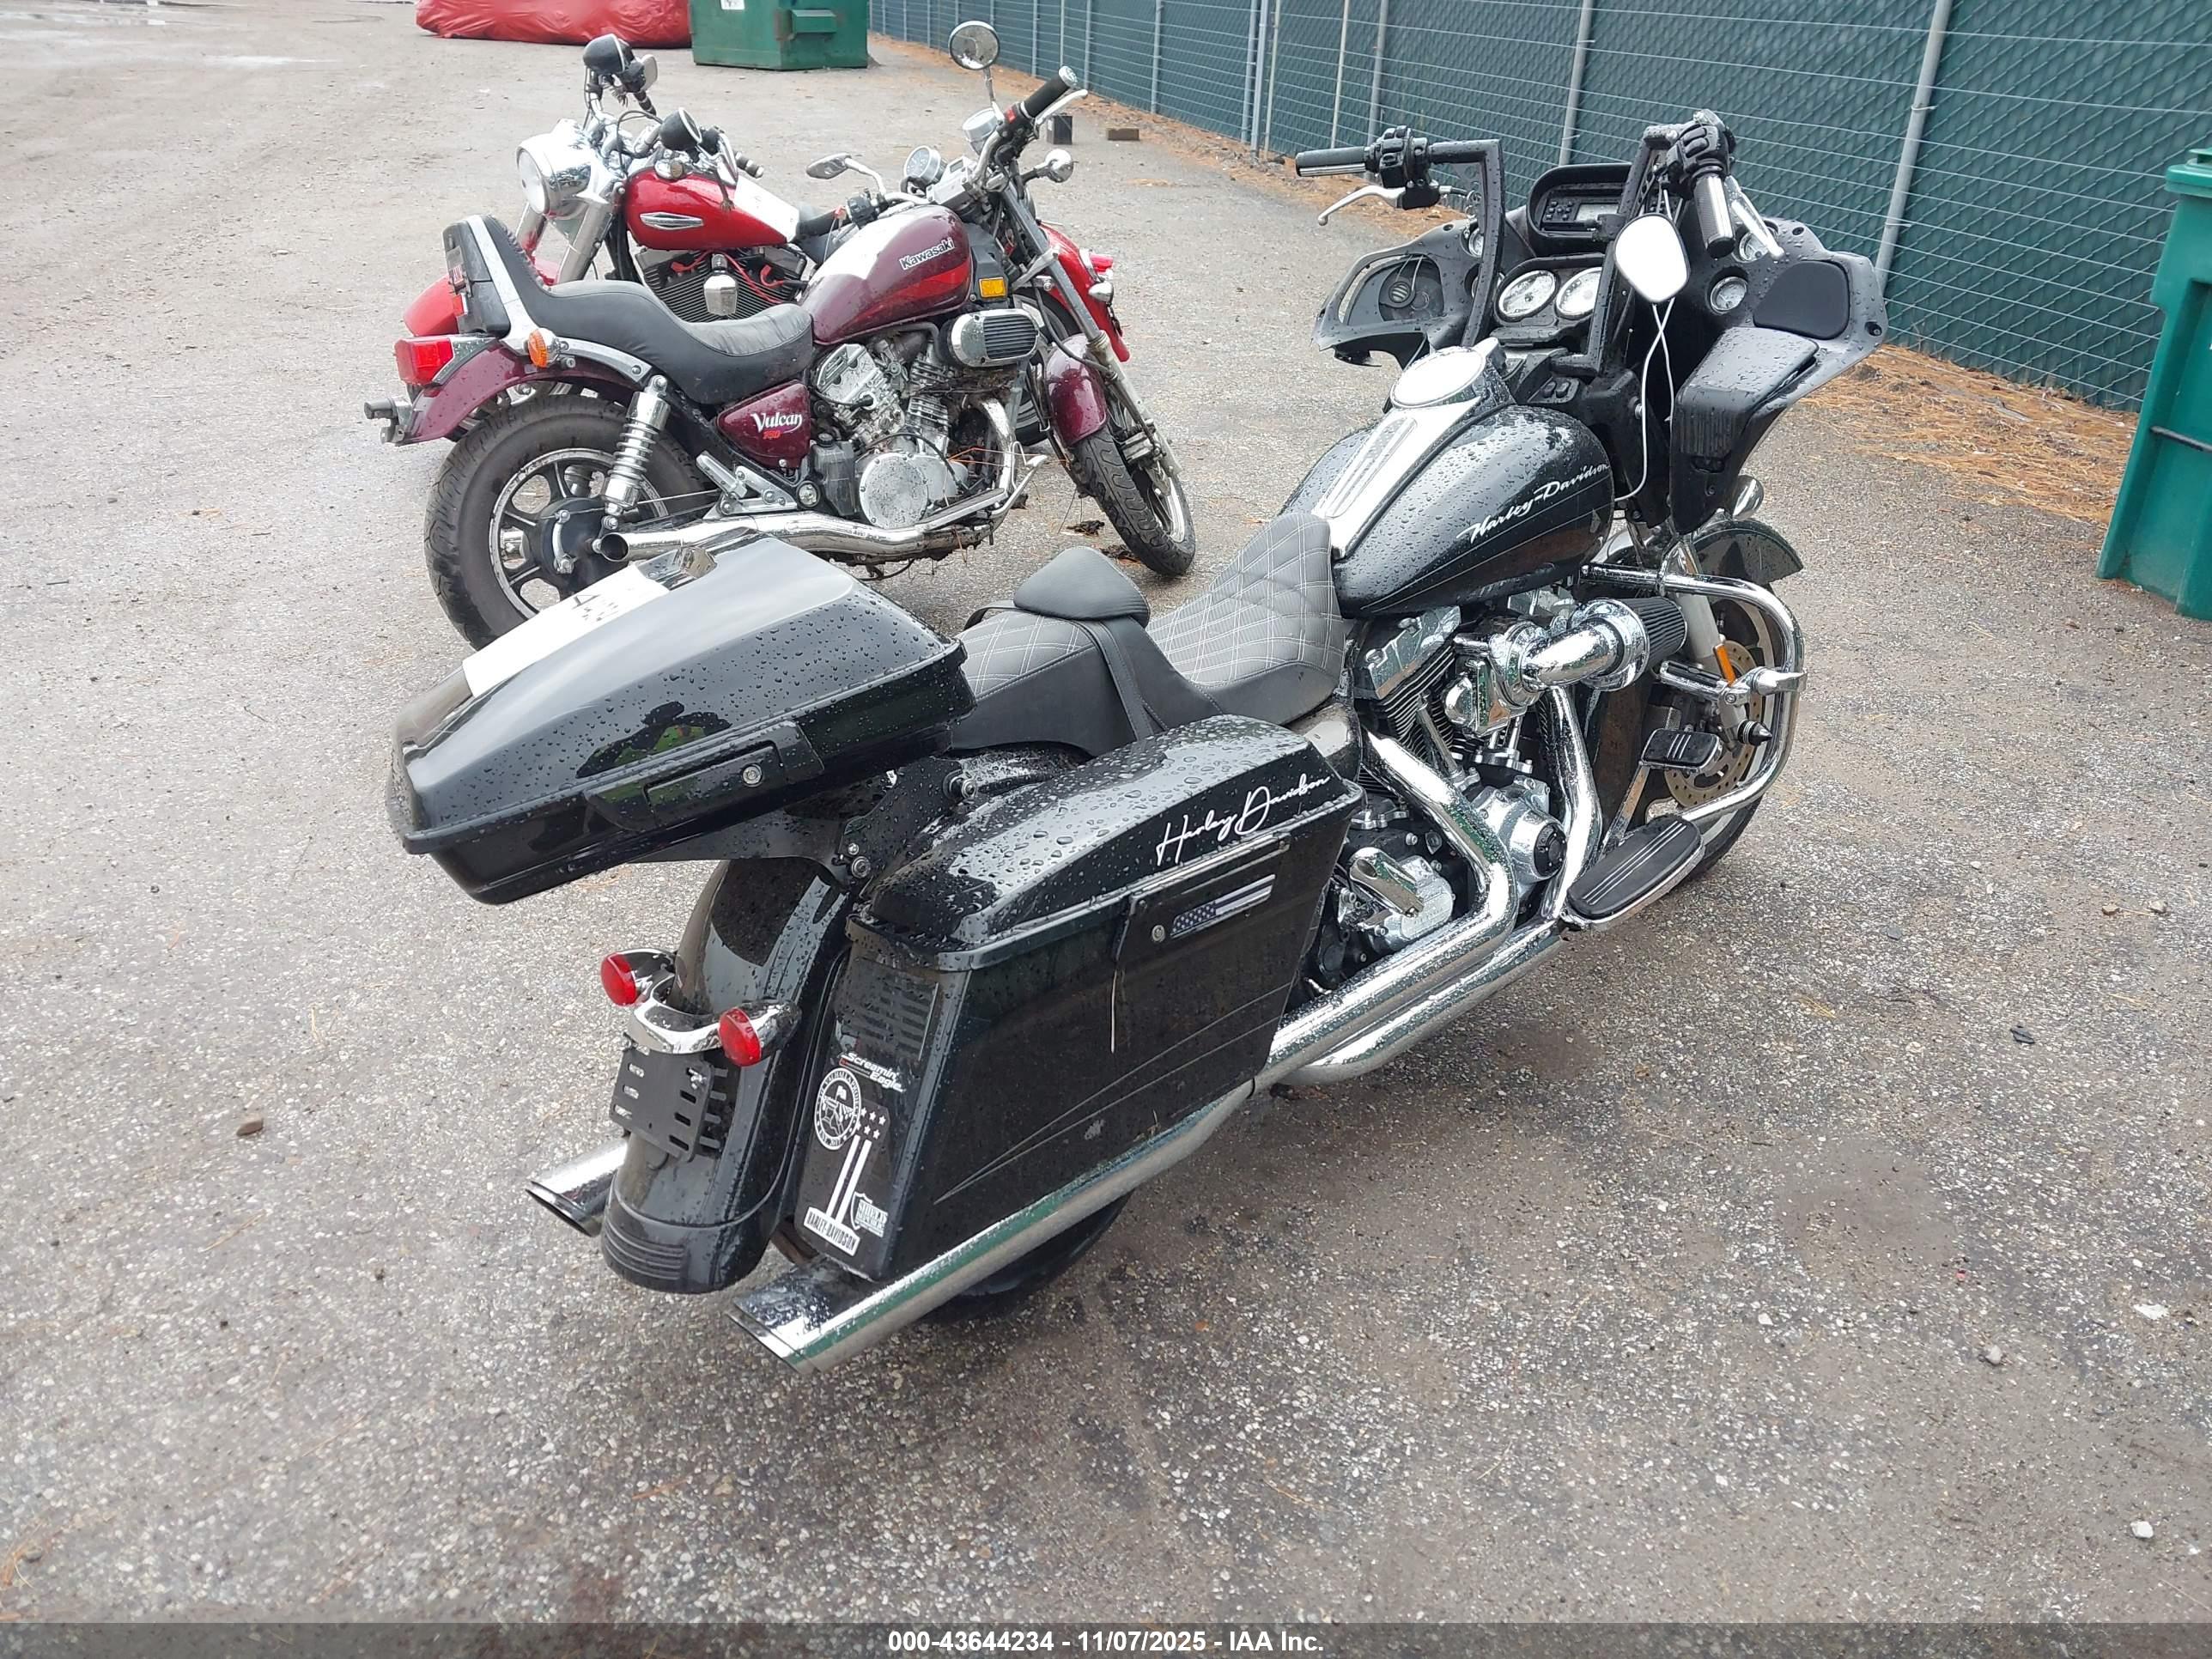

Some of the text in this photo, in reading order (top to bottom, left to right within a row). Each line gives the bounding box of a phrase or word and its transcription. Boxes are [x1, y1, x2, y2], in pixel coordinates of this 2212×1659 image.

[899, 237, 955, 270] Kawasaki
[750, 411, 803, 433] Vulcan
[1456, 464, 1610, 544] Harley-Davidson
[1156, 773, 1331, 866] Harley Davidson
[870, 1071, 906, 1092] Eagle
[806, 1212, 855, 1251] HARLEY-DAVIDSON
